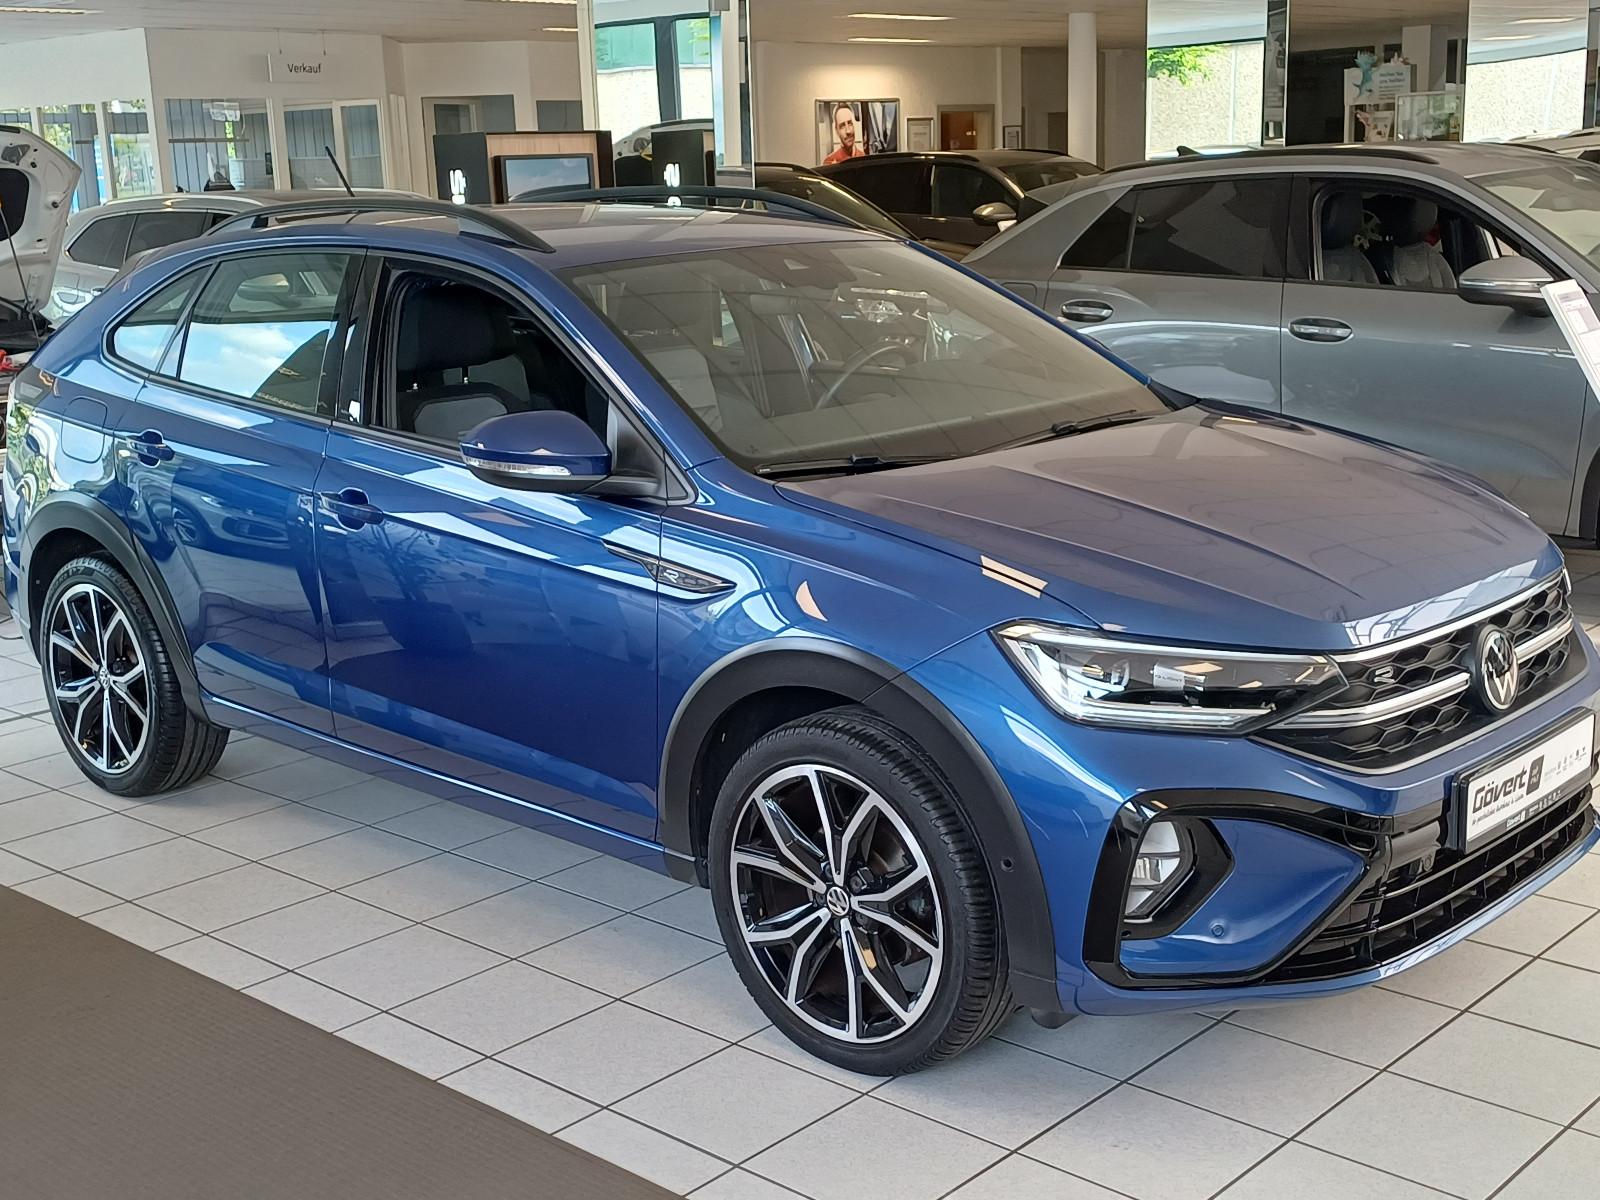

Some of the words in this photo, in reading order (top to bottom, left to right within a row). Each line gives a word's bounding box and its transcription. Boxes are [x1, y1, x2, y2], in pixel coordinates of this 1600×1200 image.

[287, 62, 322, 74] Verkauf
[663, 568, 680, 584] R
[1472, 765, 1528, 814] Gövert
